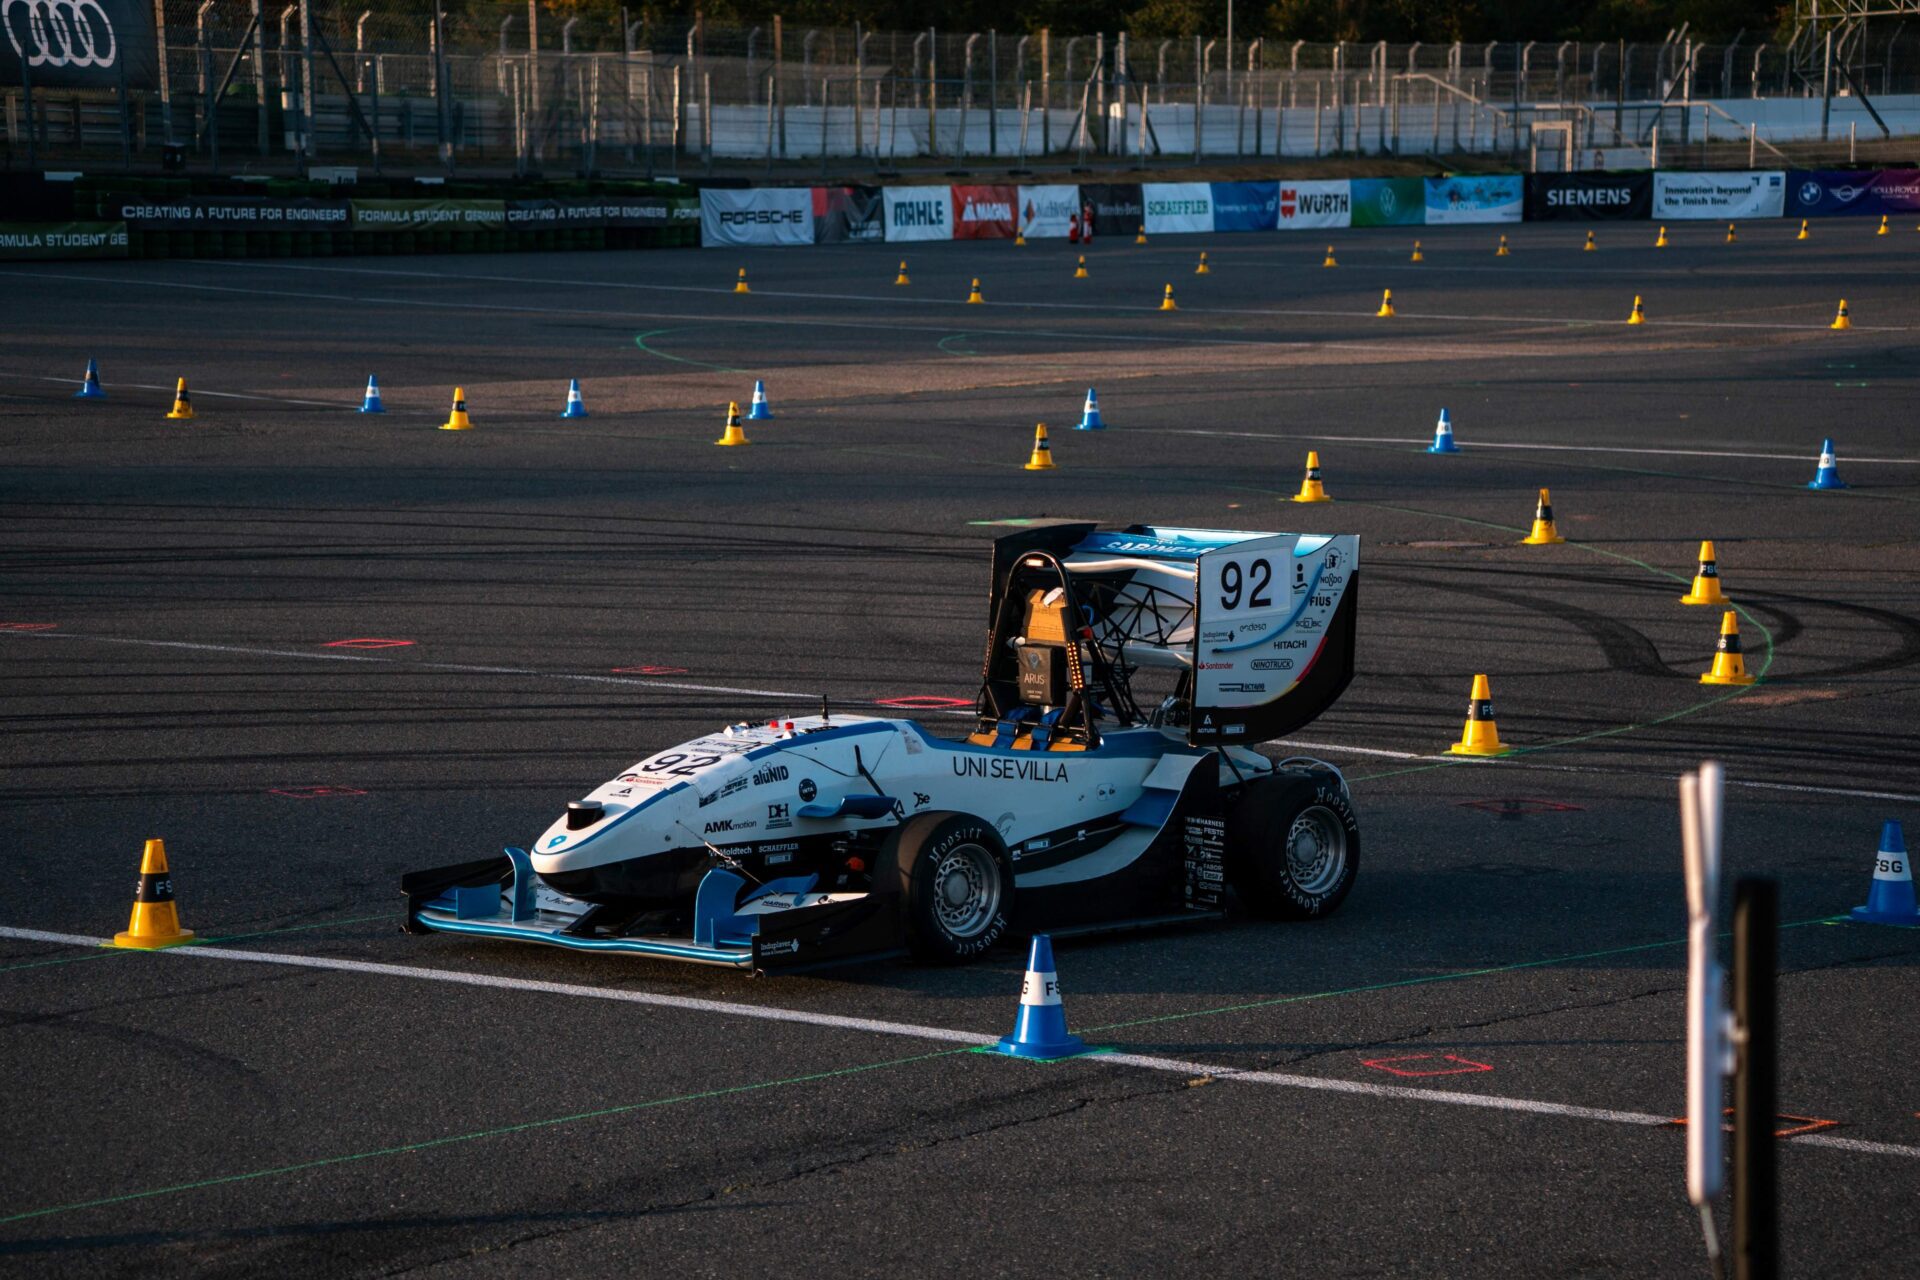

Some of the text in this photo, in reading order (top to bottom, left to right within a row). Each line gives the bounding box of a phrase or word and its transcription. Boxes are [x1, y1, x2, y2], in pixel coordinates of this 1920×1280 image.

[1547, 187, 1633, 206] SIEMENS
[1664, 184, 1752, 200] Innovation beyond
[1298, 194, 1349, 214] WÜRTH
[1664, 195, 1730, 207] the finish line.
[121, 205, 347, 221] CREATING A FUTURE FOR ENGINEERS
[358, 210, 410, 223] FORMULA
[413, 209, 462, 223] STUDENT
[507, 205, 667, 222] CREATING A FUTURE FOR ENGINEERS
[719, 209, 804, 225] PORSCHE
[894, 200, 943, 226] MAHLE
[46, 233, 106, 247] STUDENT
[1220, 557, 1272, 611] 92
[1273, 640, 1308, 650] HITACHI
[1205, 661, 1234, 670] Santander
[1024, 672, 1045, 685] ARUS
[758, 843, 800, 854] SCHAEFFLER
